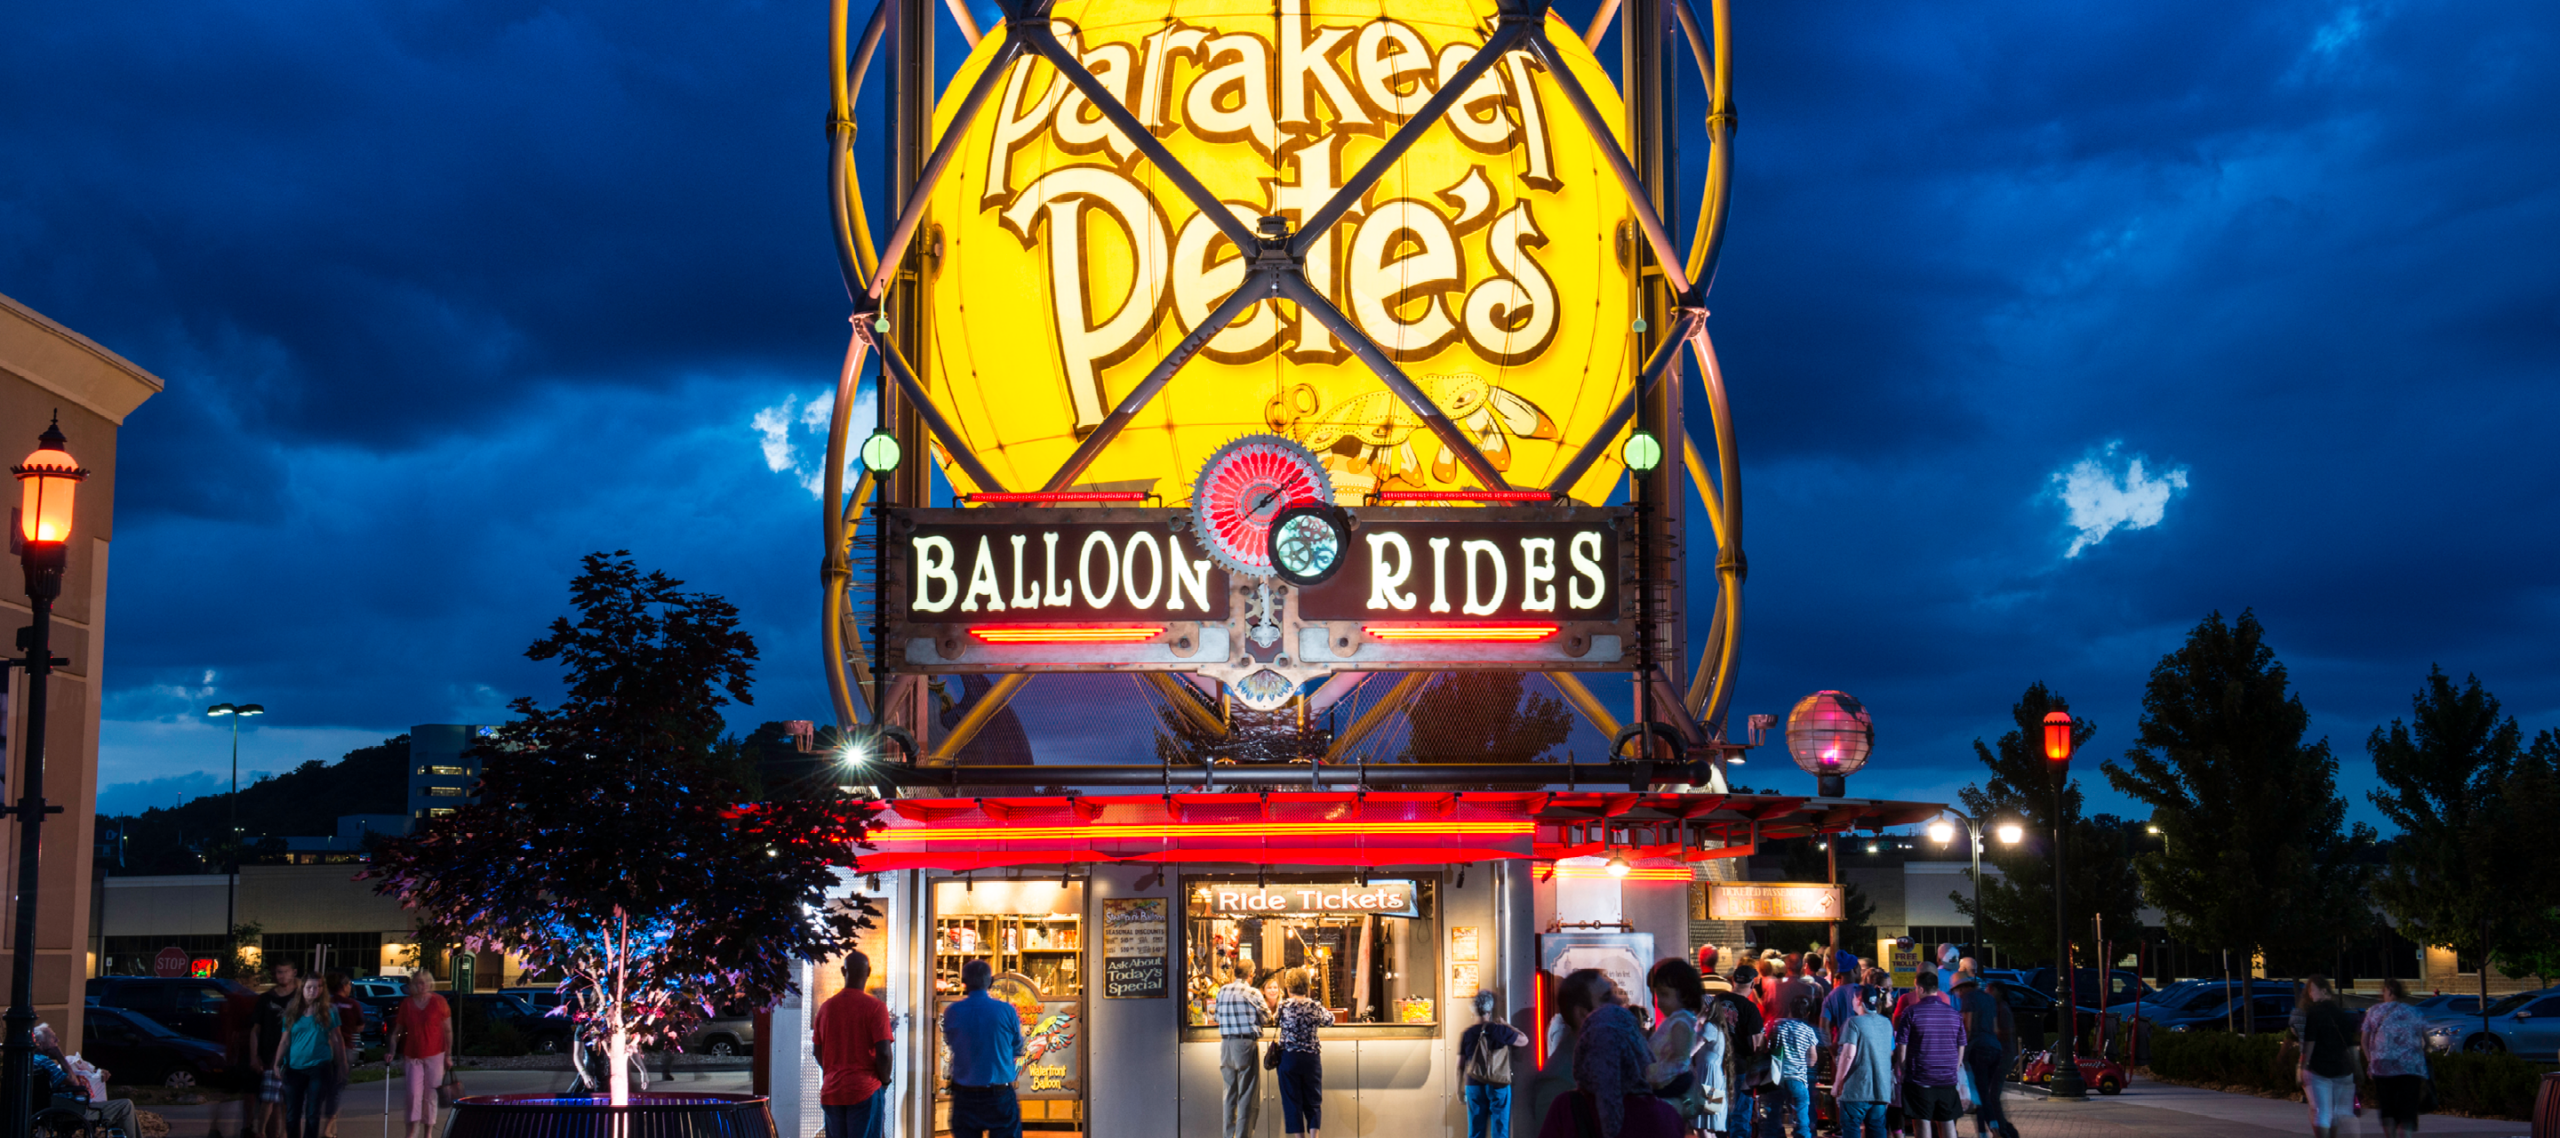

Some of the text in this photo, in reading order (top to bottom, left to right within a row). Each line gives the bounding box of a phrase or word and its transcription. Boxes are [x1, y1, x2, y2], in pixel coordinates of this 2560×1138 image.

[1000, 130, 1560, 441] Pete's
[911, 531, 1606, 615] BALLOON RIDES
[1721, 887, 1761, 896] TICKETED
[1218, 887, 1405, 911] Ride Tickets
[1728, 896, 1806, 916] ENTER HERE
[157, 957, 186, 970] STOP
[1107, 957, 1162, 970] Ask About
[1107, 968, 1162, 982] Today's
[1108, 978, 1162, 996] Special
[1029, 1064, 1066, 1077] Waterfront
[1031, 1077, 1061, 1090] Balloon
